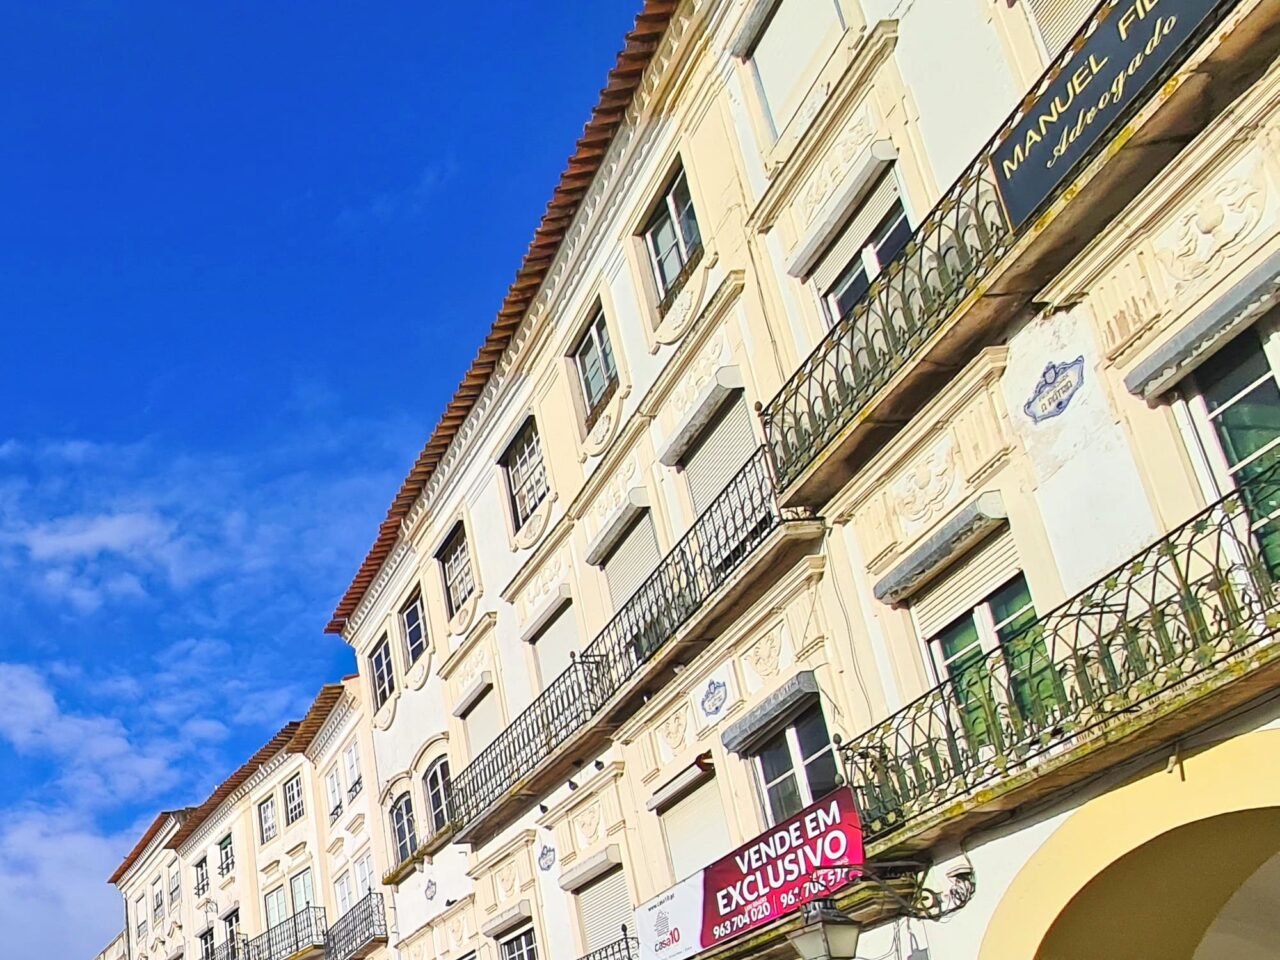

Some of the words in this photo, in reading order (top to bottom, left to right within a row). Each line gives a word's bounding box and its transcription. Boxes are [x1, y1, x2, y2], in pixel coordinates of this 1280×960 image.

[1002, 53, 1109, 179] MANUEL
[1046, 14, 1178, 169] Advogado
[716, 829, 848, 916] EXCLUSIVO
[735, 821, 804, 874] VENDE
[805, 800, 841, 836] EM
[654, 927, 680, 952] casa10
[713, 919, 732, 940] 963
[732, 912, 750, 931] 704
[751, 902, 771, 921] 020
